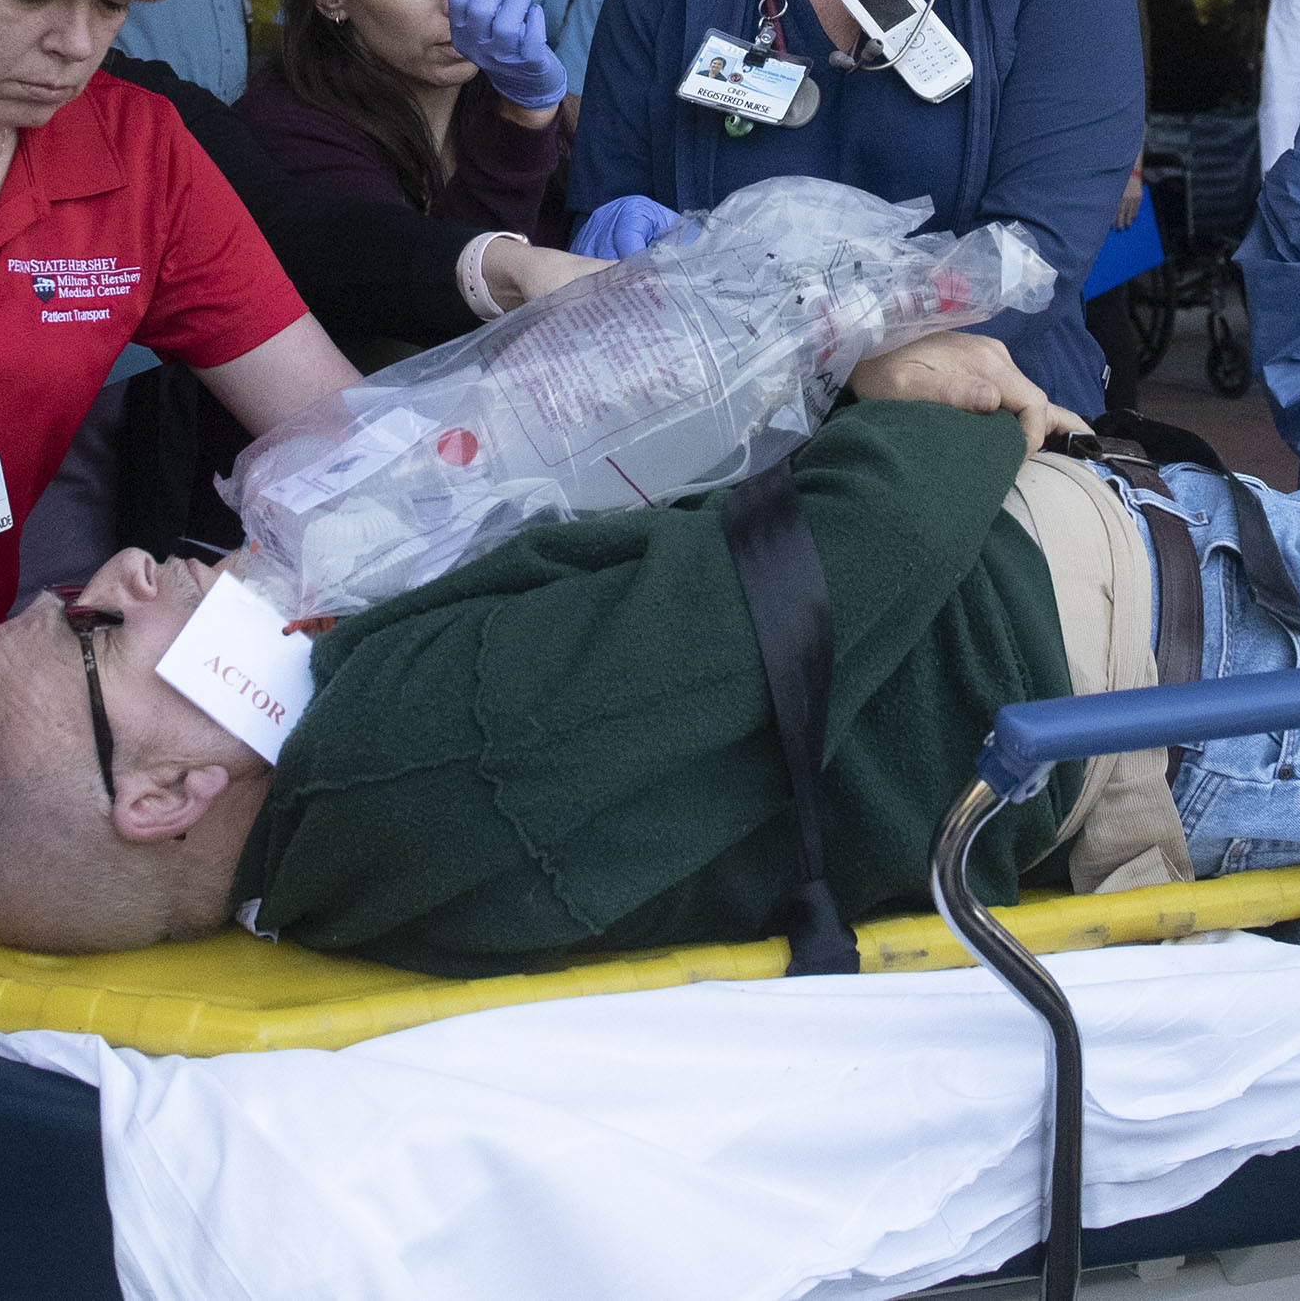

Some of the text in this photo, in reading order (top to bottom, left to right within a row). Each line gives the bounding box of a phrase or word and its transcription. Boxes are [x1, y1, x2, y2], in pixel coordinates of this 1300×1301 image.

[727, 86, 749, 97] CINDY
[697, 87, 772, 114] REGISTERED NURSE
[57, 272, 141, 286] Milton S. Hershey
[58, 285, 131, 298] Medical Center
[41, 308, 110, 323] Patient Transport
[203, 655, 286, 726] ACTOR
